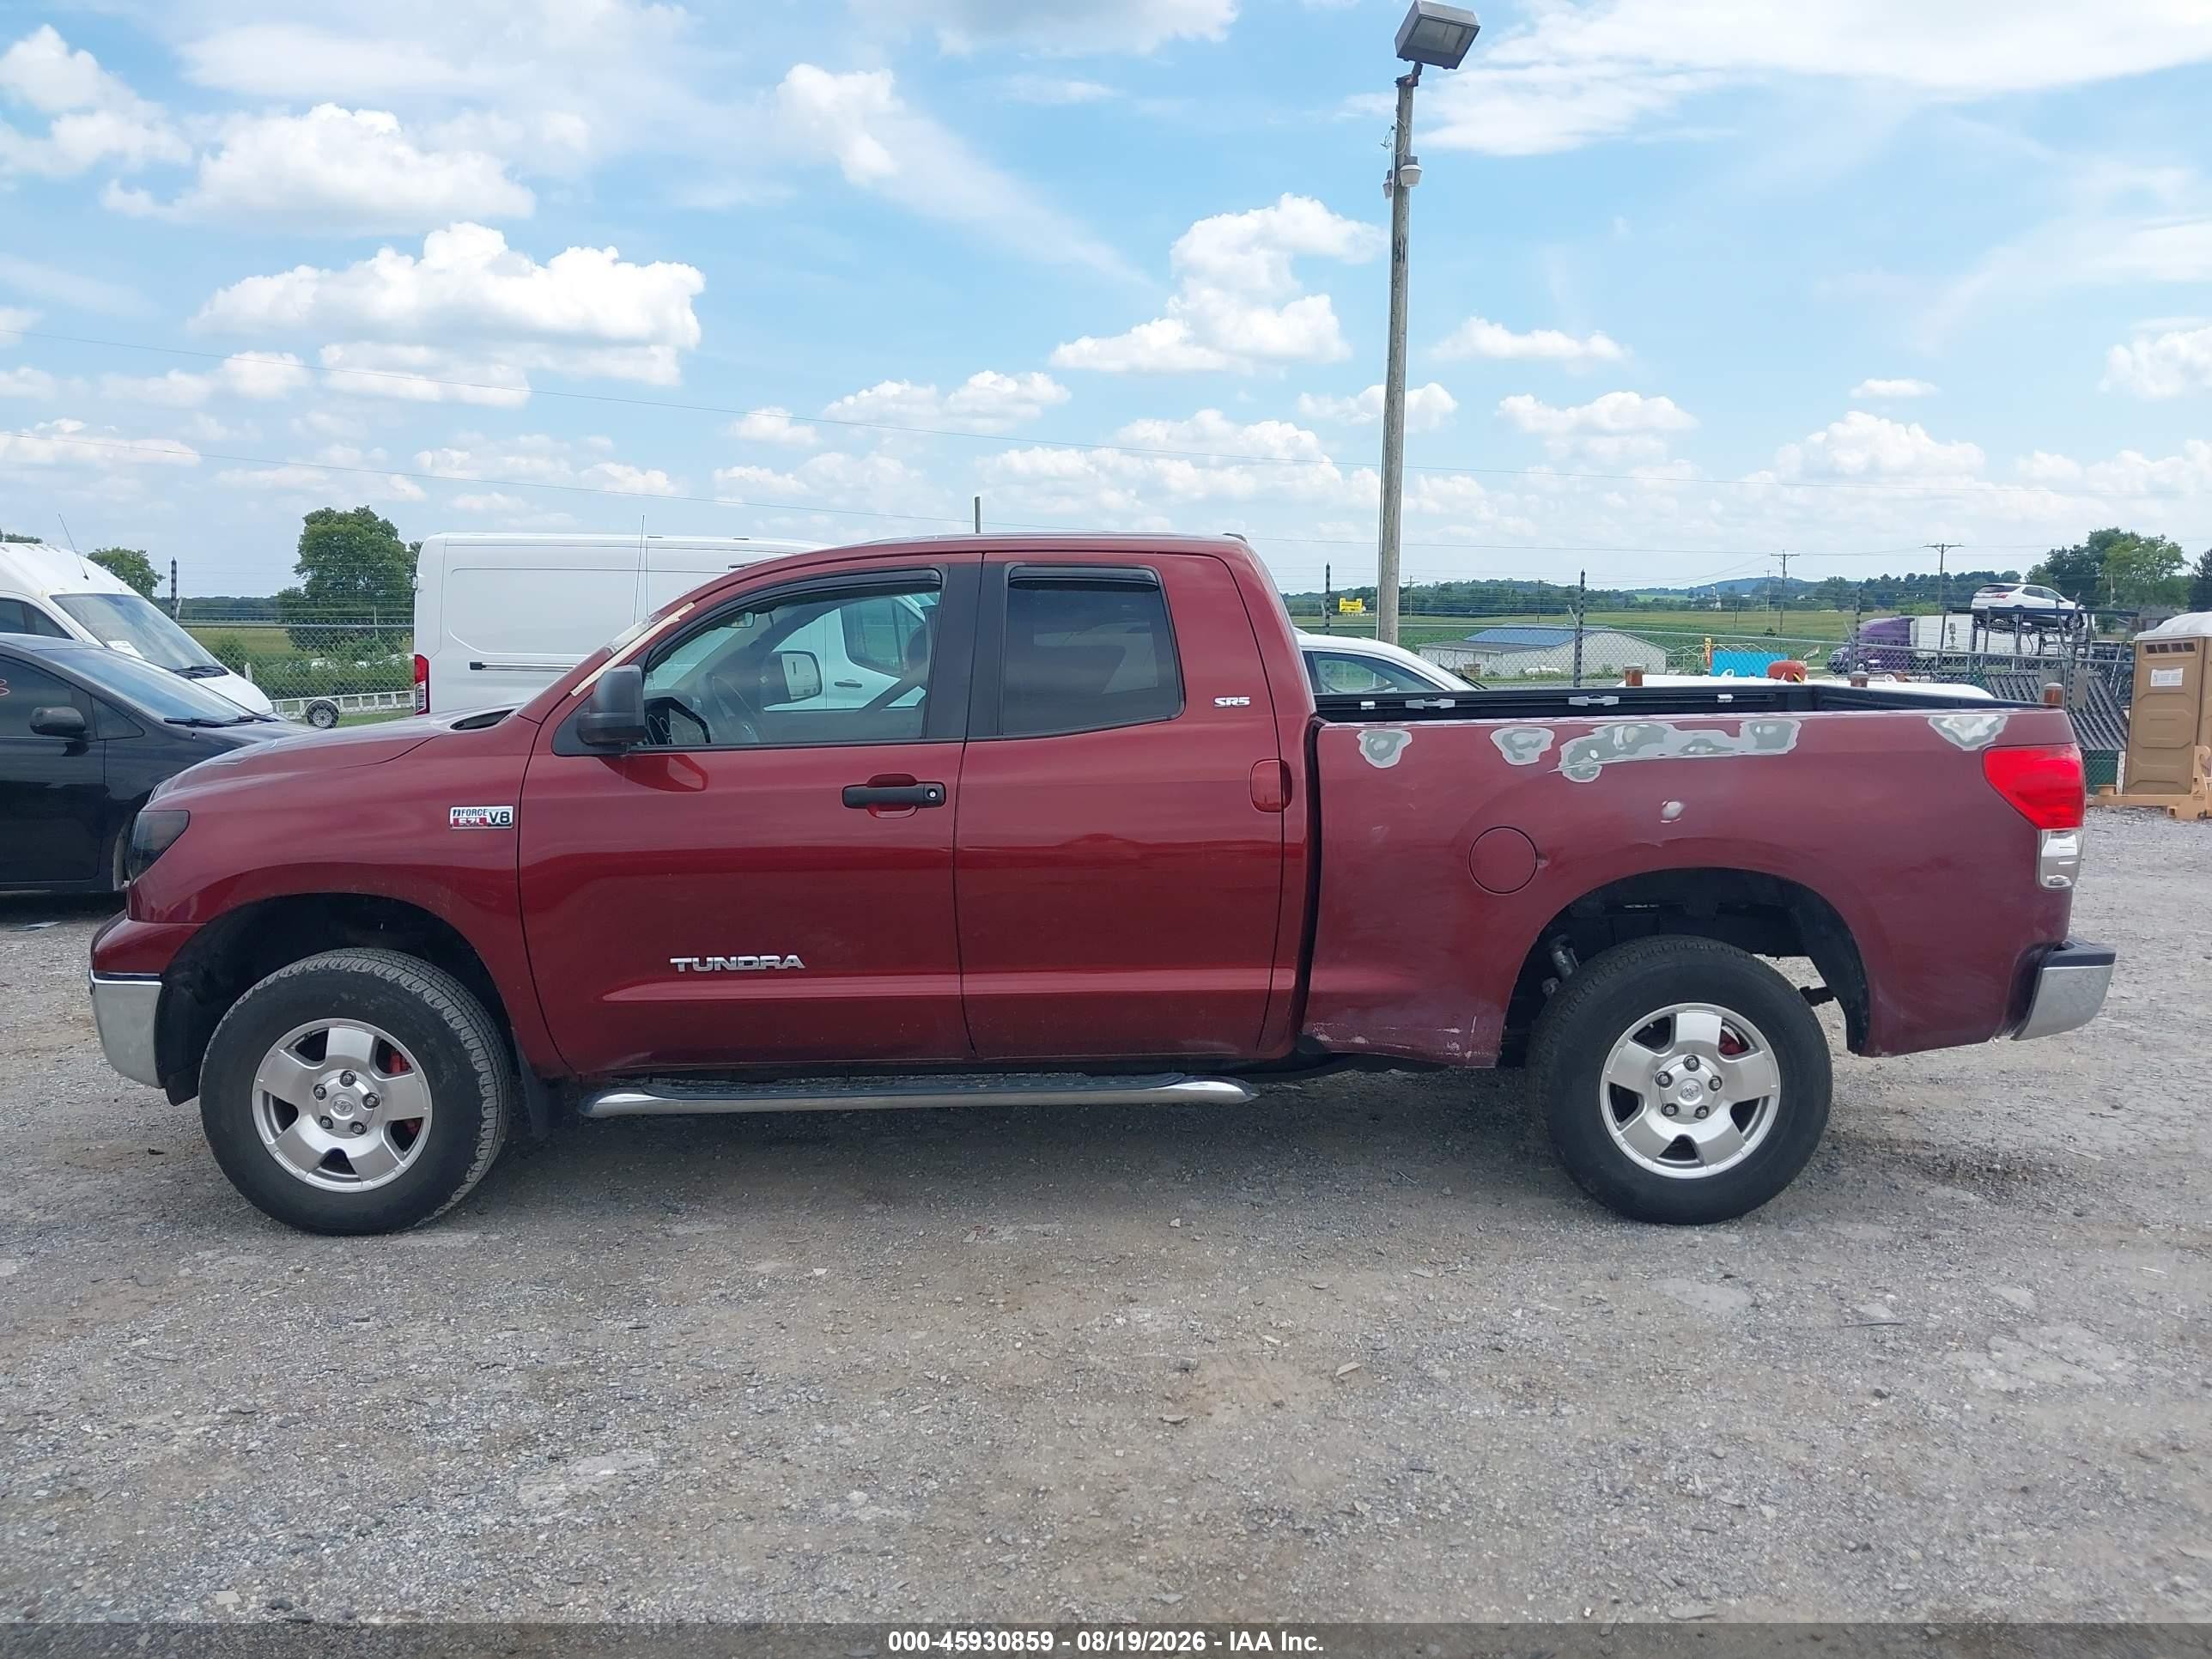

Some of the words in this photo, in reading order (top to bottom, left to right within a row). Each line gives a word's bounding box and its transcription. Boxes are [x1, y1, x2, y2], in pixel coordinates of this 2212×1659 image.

[1214, 696, 1250, 707] SR5
[489, 811, 510, 823] V8
[670, 955, 805, 972] TUNDRA
